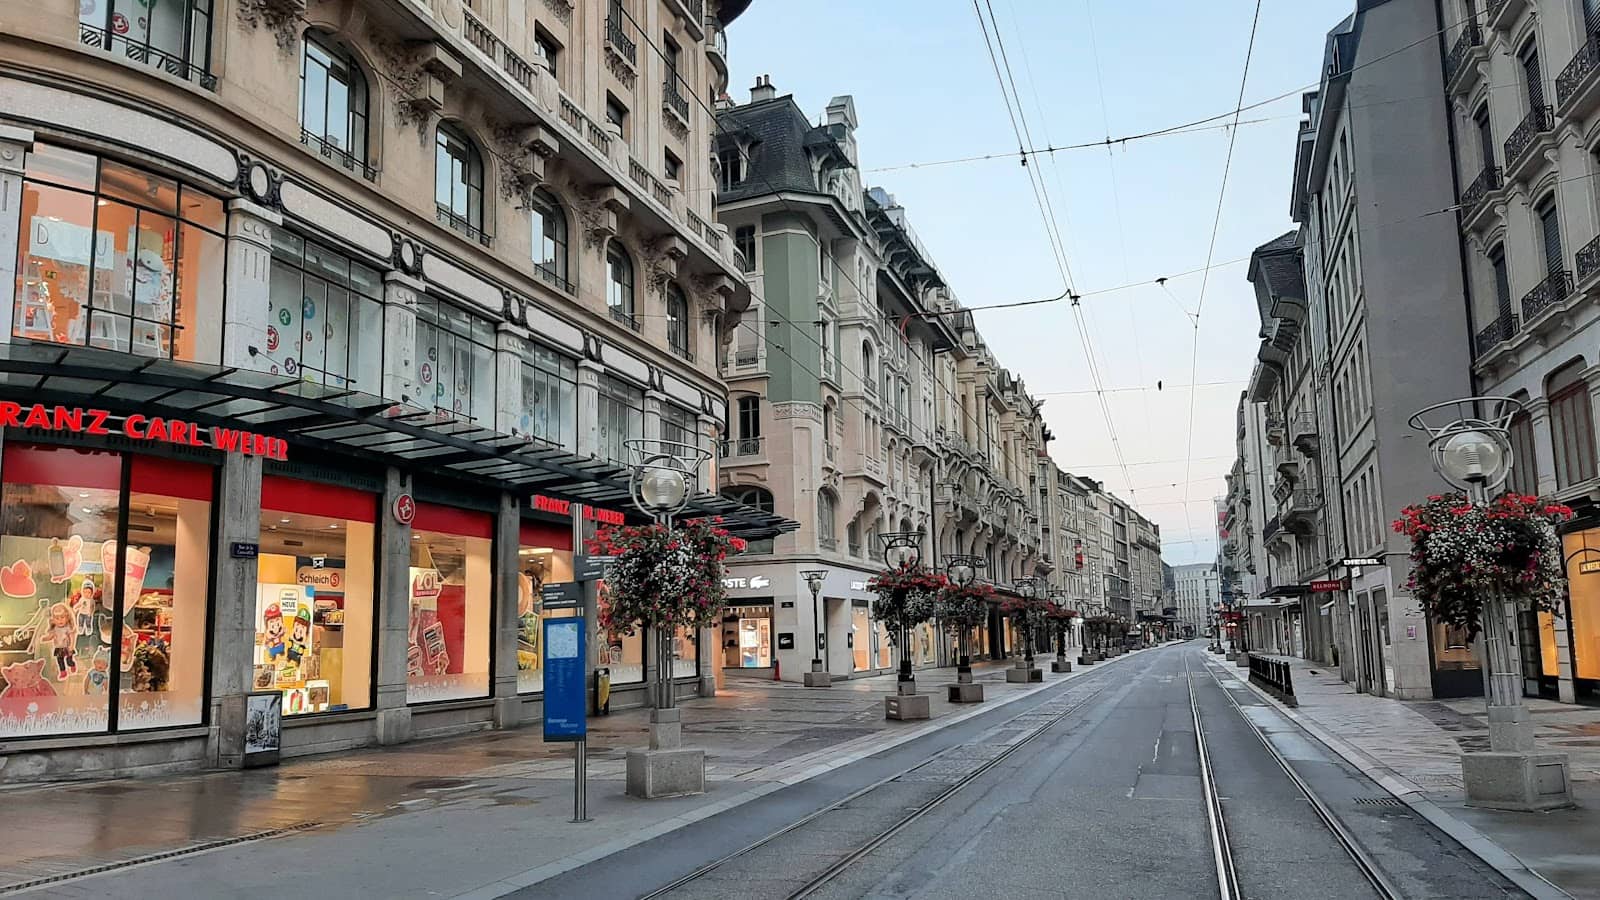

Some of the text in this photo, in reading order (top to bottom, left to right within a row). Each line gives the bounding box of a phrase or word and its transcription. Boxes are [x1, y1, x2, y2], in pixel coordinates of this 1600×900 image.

[0, 401, 289, 461] RANZ CARL WEBER
[532, 494, 625, 526] FRANZ RL WEBER
[1343, 558, 1380, 566] DIESEL
[299, 572, 330, 585] Schleich
[415, 571, 442, 591] LOL
[720, 577, 747, 589] OSTE
